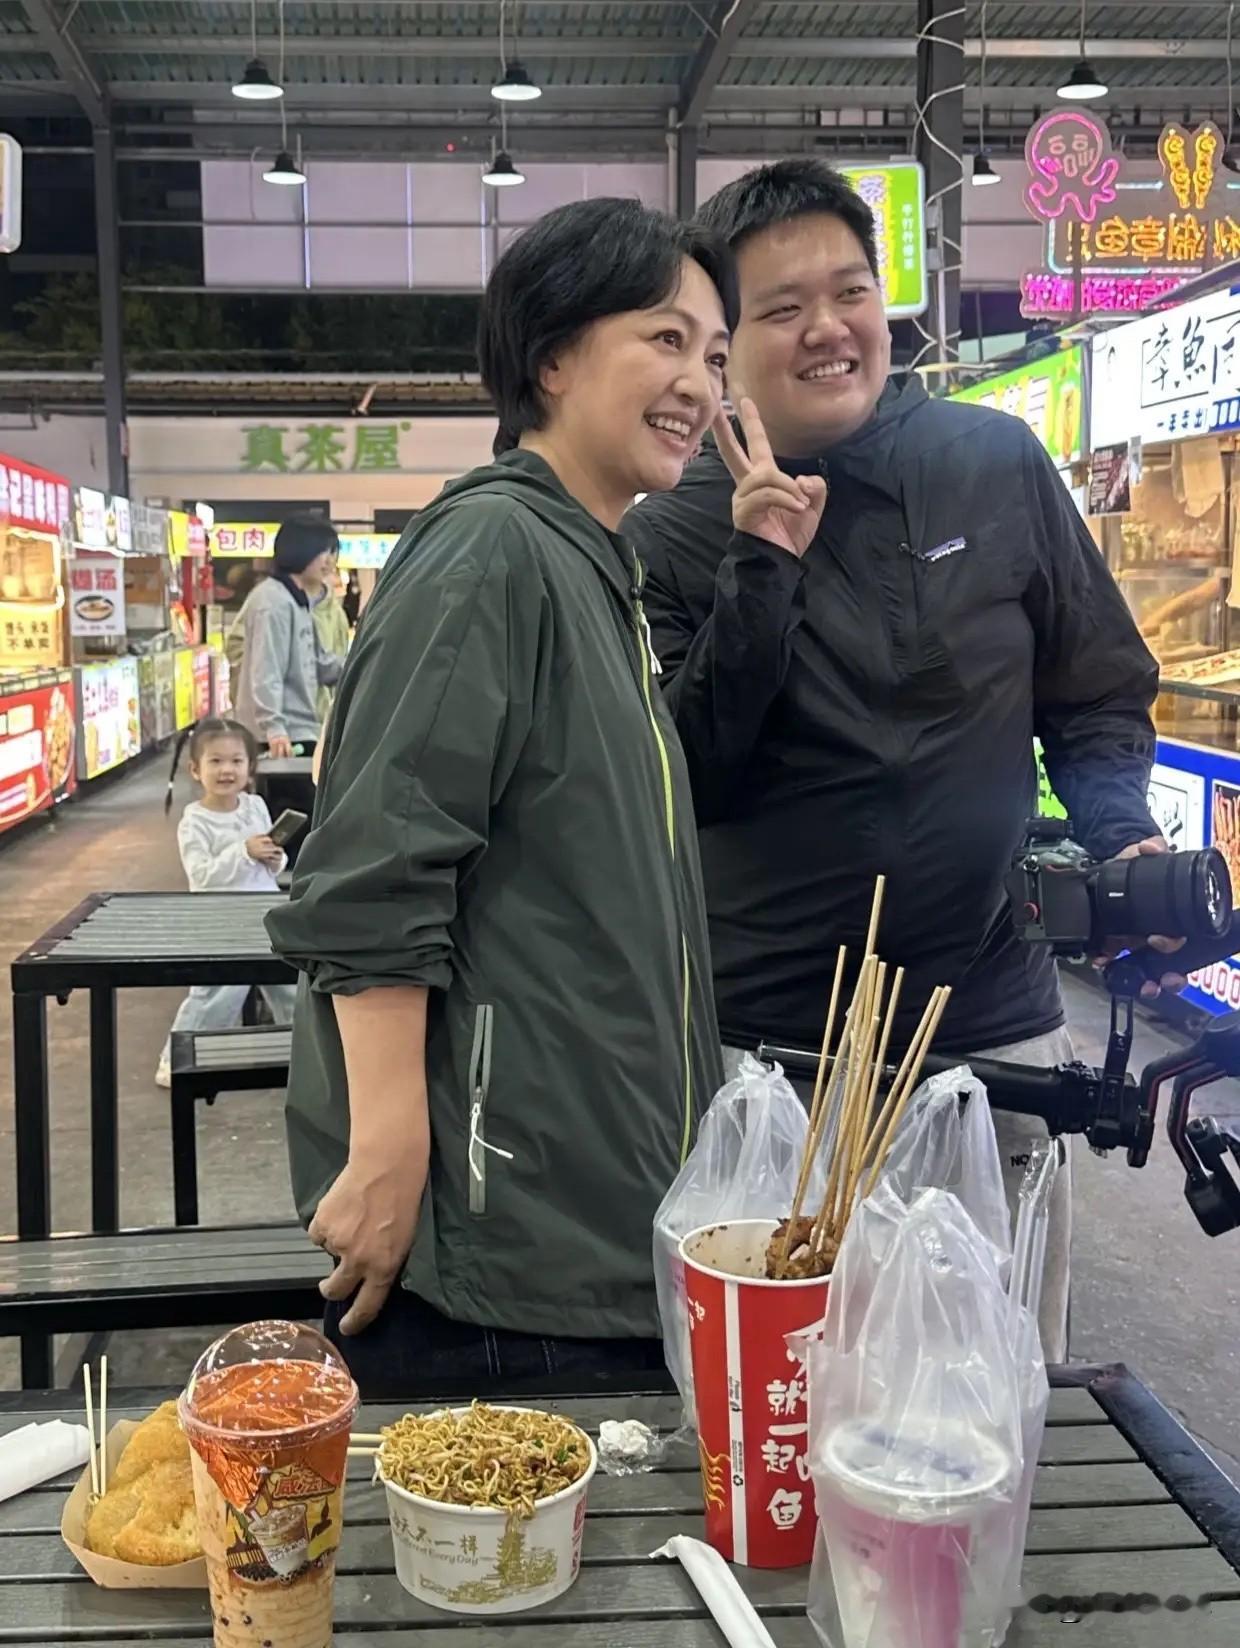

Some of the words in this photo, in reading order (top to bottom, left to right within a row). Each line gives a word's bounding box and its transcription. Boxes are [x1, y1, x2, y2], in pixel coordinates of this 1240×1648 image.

[240, 423, 402, 473] 真茶屋
[215, 528, 265, 550] 包肉
